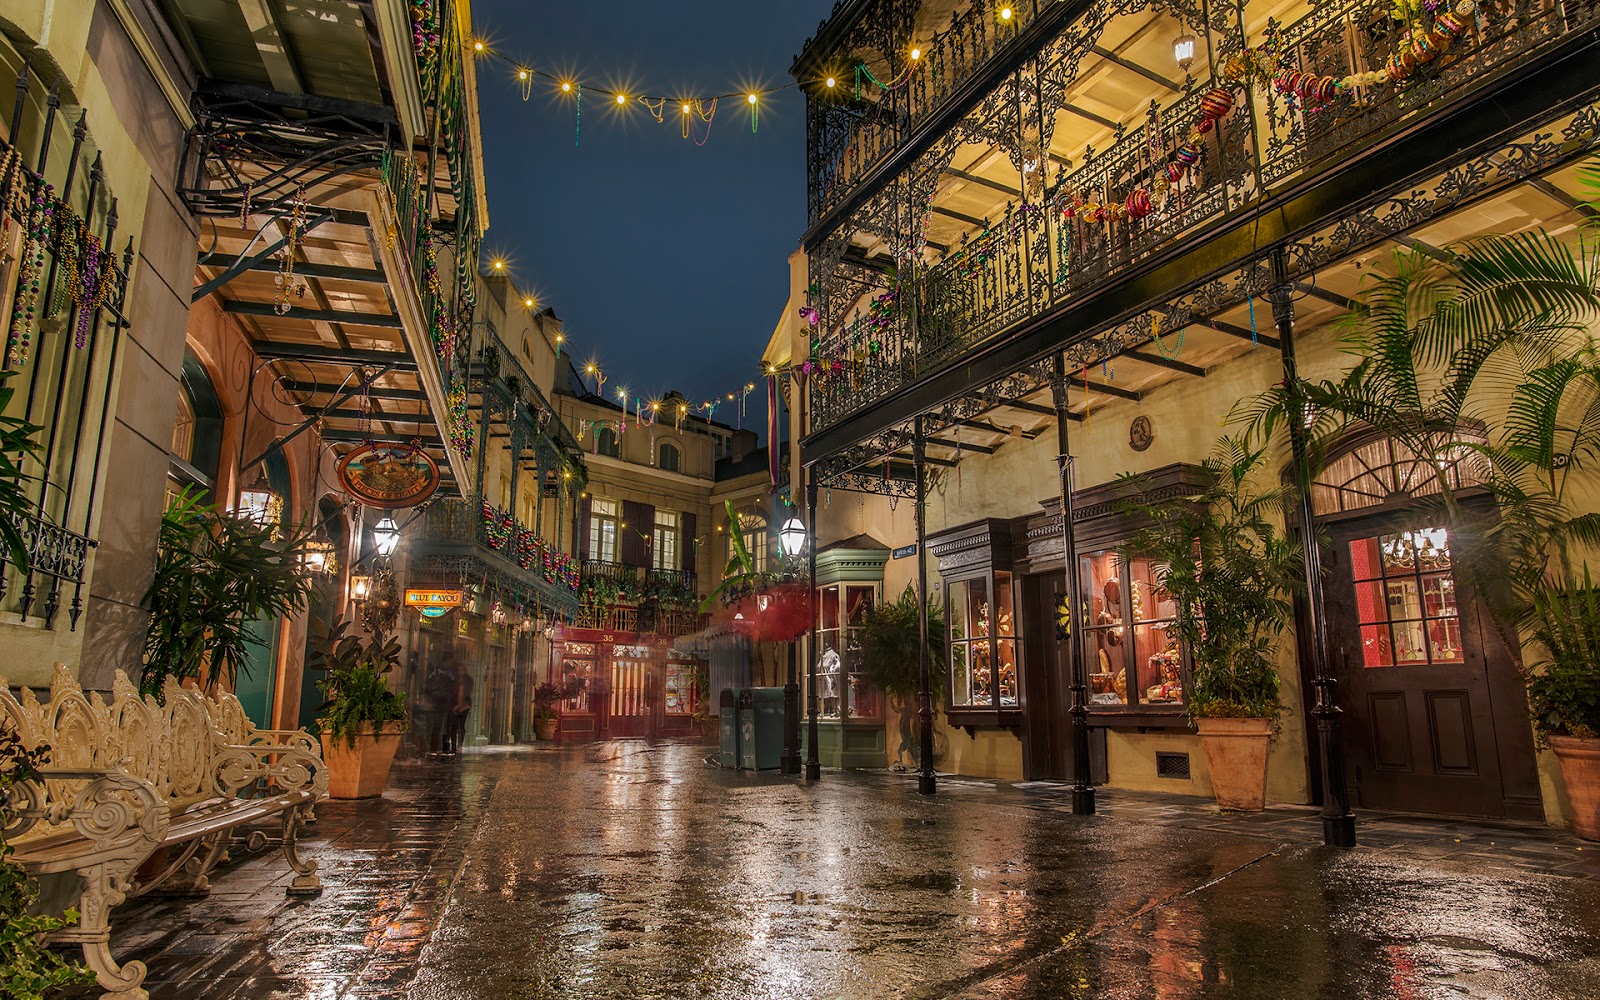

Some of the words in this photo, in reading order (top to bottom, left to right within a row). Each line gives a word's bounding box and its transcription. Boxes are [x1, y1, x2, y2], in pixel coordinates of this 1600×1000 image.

[354, 481, 381, 498] PIECES
[395, 484, 420, 499] EIGHT
[431, 593, 459, 603] BAYOU
[603, 634, 614, 642] 35
